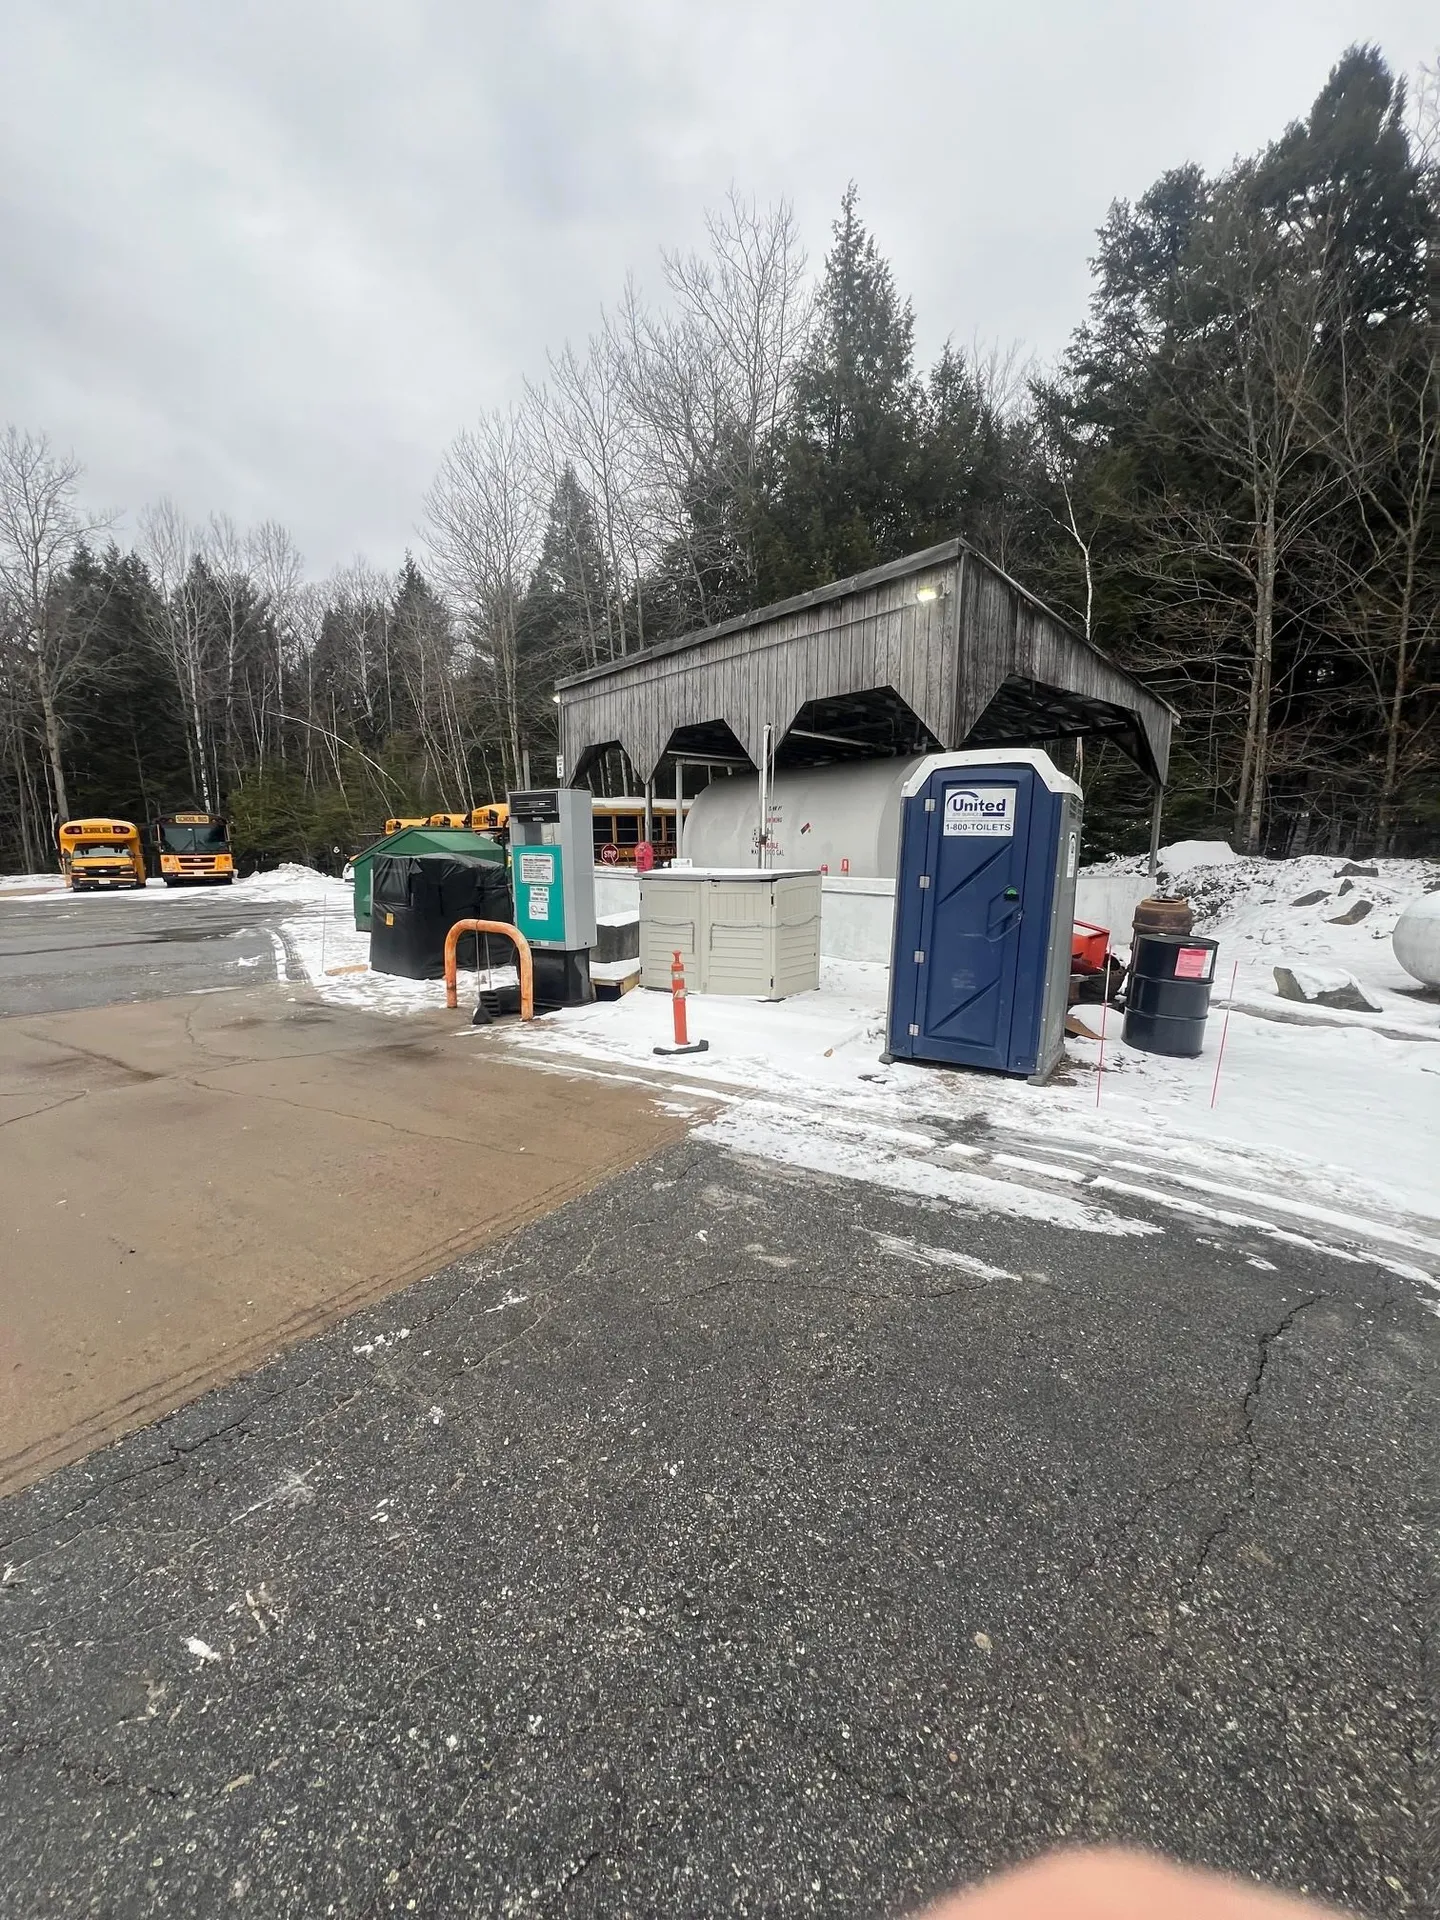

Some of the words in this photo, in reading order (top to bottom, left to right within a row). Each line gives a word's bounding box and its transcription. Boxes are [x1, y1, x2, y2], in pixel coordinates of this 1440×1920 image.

[953, 799, 1006, 812] United
[83, 826, 100, 834] SCHOOL
[102, 826, 112, 834] BUS
[946, 823, 1011, 831] 1-800-TOILETS
[603, 850, 617, 858] STOP
